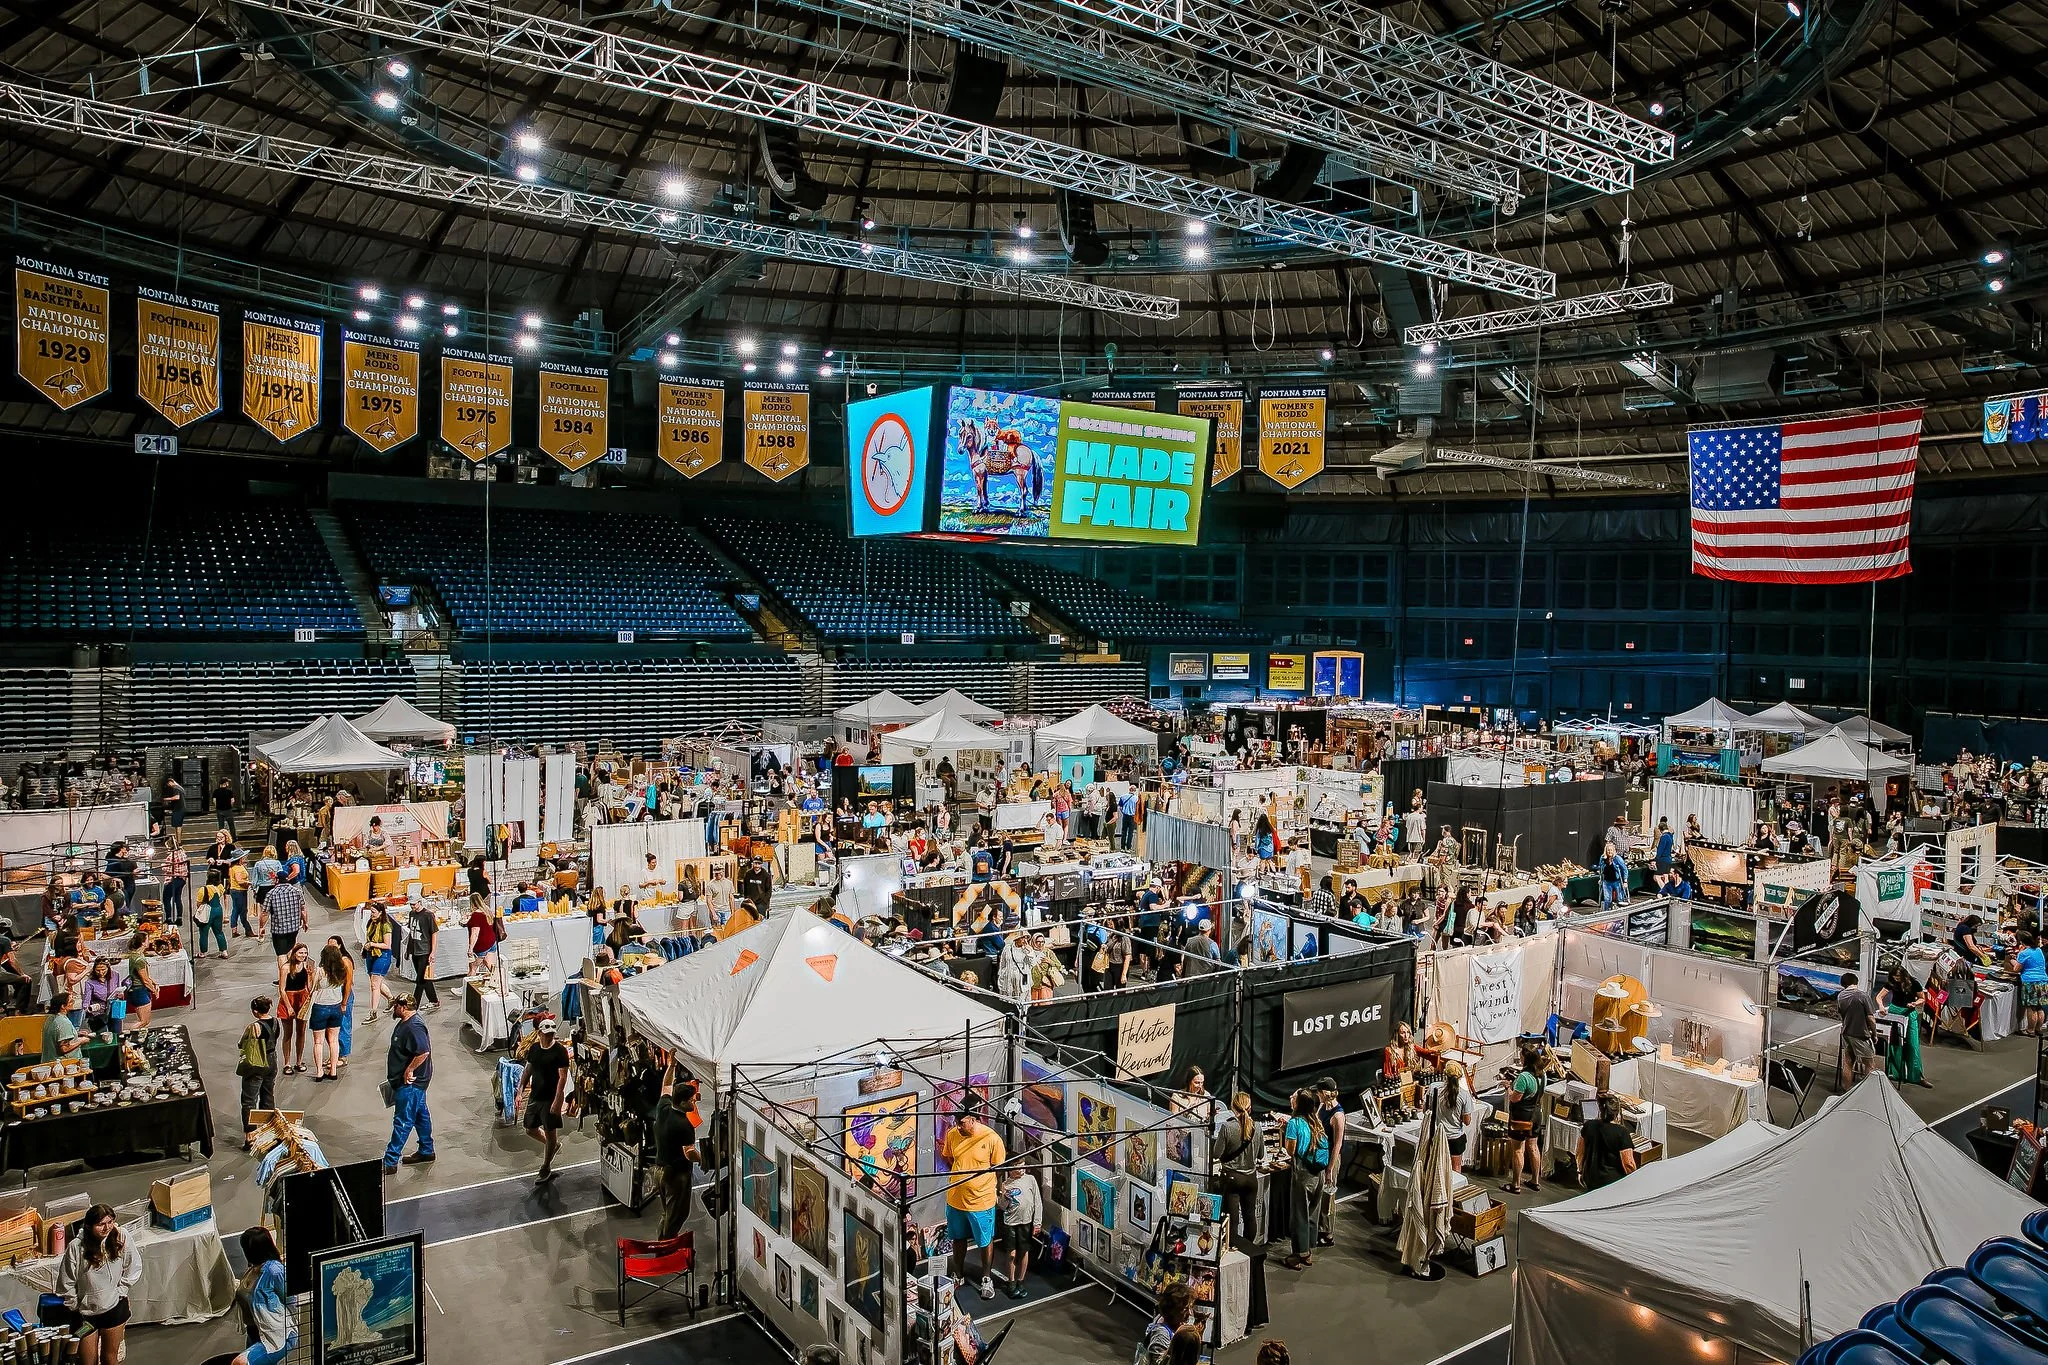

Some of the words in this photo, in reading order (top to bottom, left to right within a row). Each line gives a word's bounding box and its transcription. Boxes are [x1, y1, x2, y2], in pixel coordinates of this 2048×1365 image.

[16, 255, 74, 278] MONTANA
[78, 271, 109, 286] STATE
[44, 282, 83, 300] MEN'S
[23, 289, 102, 315] BASKETBALL
[138, 286, 189, 305] MONTANA
[191, 298, 219, 313] STATE
[28, 306, 100, 330] NATIONAL
[150, 312, 207, 333] FOOTBALL
[244, 309, 292, 329] MONTANA
[294, 319, 321, 333] STATE
[21, 317, 105, 343] CHAMPIONS
[148, 334, 211, 355] NATIONAL
[267, 331, 300, 346] MEN'S
[345, 331, 391, 347] MONTANA
[393, 339, 420, 350] STATE
[38, 339, 91, 364] 1929
[265, 340, 301, 355] RODEO
[142, 344, 216, 367] CHAMPIONS
[253, 353, 312, 372] NATIONAL
[367, 350, 398, 362] MEN'S
[442, 347, 486, 361] MONTANA
[488, 353, 513, 364] STATE
[365, 358, 400, 372] RODEO
[540, 361, 582, 373] MONTANA
[584, 366, 609, 376] STATE
[157, 363, 202, 386] 1956
[247, 364, 318, 384] CHAMPIONS
[353, 369, 411, 386] NATIONAL
[452, 367, 502, 382] FOOTBALL
[660, 374, 700, 385] MONTANA
[702, 378, 724, 387] STATE
[261, 381, 304, 403] 1972
[348, 380, 416, 397] CHAMPIONS
[449, 382, 505, 397] NATIONAL
[550, 381, 598, 394] FOOTBALL
[744, 381, 784, 390] MONTANA
[786, 383, 809, 391] STATE
[1302, 389, 1326, 397] STATE
[445, 392, 510, 407] CHAMPIONS
[548, 395, 601, 409] NATIONAL
[671, 389, 712, 400] WOMEN'S
[676, 397, 707, 407] RODEO
[1092, 391, 1130, 399] MONTANA
[1132, 391, 1155, 399] STATE
[1179, 391, 1218, 399] MONTANA
[1220, 390, 1243, 398] STATE
[361, 396, 403, 414] 1975
[542, 404, 605, 418] CHAMPIONS
[666, 407, 716, 418] NATIONAL
[762, 403, 792, 411] RODEO
[1190, 404, 1232, 412] WOMEN'S
[1272, 403, 1314, 411] WOMEN'S
[457, 407, 497, 425] 1976
[661, 415, 721, 427] CHAMPIONS
[752, 414, 802, 423] NATIONAL
[1278, 410, 1308, 418] RODEO
[554, 419, 593, 435] 1984
[747, 423, 807, 432] CHAMPIONS
[1068, 416, 1142, 437] BOZEMAN
[1144, 425, 1196, 443] SPRING
[1267, 421, 1317, 429] NATIONAL
[672, 429, 710, 443] 1986
[758, 435, 795, 448] 1988
[1262, 430, 1322, 438] CHAMPIONS
[142, 437, 171, 452] 210
[1273, 442, 1311, 455] 2021
[602, 449, 623, 463] 08
[1065, 439, 1196, 486] MADE
[1061, 483, 1192, 532] FAIR
[297, 631, 312, 641] 110
[620, 632, 633, 643] 108
[1174, 663, 1188, 674] AIR
[1293, 1015, 1335, 1037] LOST
[1340, 1005, 1382, 1028] SAGE
[344, 1343, 395, 1360] YELLOWSTONE
